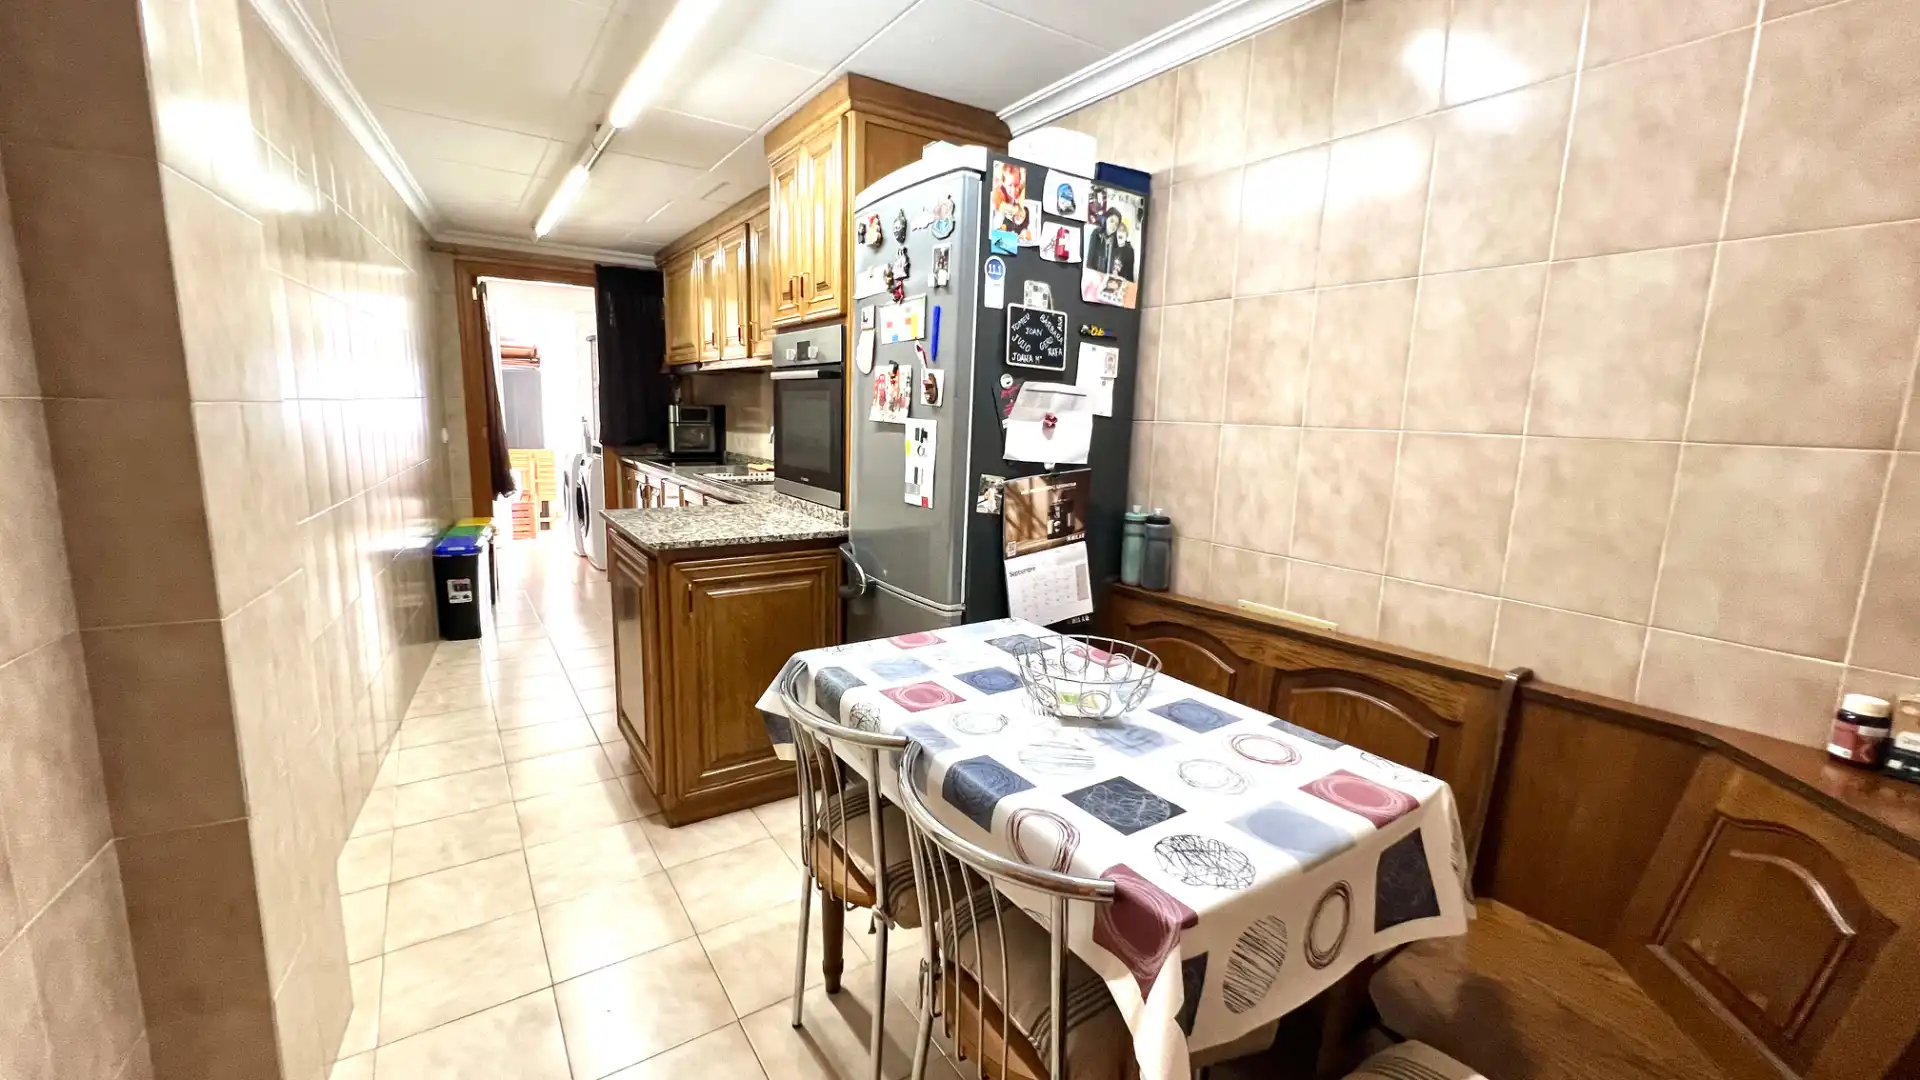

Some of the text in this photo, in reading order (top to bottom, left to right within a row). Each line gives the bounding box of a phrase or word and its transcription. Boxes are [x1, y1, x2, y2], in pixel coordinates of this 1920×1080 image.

[1025, 327, 1043, 336] JOAN
[1011, 334, 1031, 352] JULIO
[1011, 352, 1033, 363] JOANA
